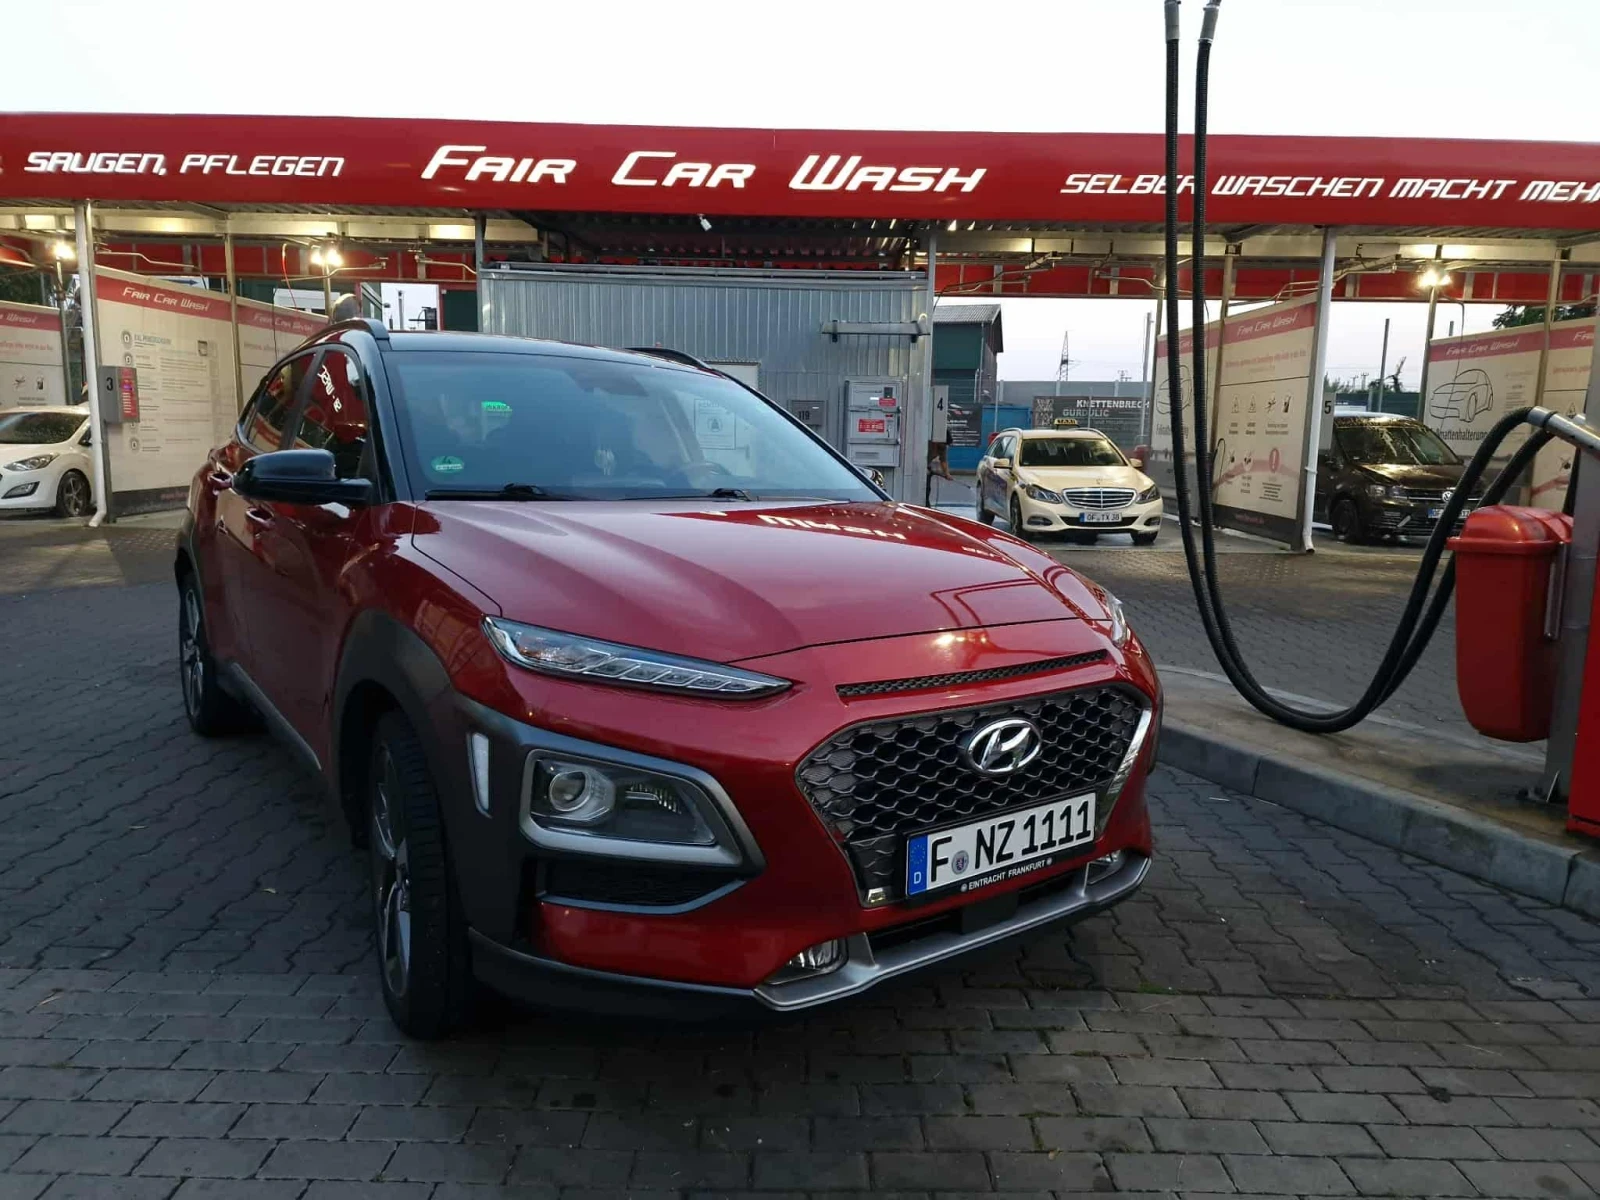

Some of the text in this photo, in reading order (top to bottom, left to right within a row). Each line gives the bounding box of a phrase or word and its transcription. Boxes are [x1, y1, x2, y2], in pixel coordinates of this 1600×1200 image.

[179, 153, 345, 176] PFLEGEN
[1211, 175, 1386, 197] WASCHEN
[1388, 178, 1518, 199] MACHT
[106, 376, 114, 391] 3
[936, 397, 944, 411] 4
[1324, 400, 1332, 415] 5
[913, 800, 1091, 885] D F NZ 1111
[968, 860, 1046, 891] EINTRACHT FRANKFURT
